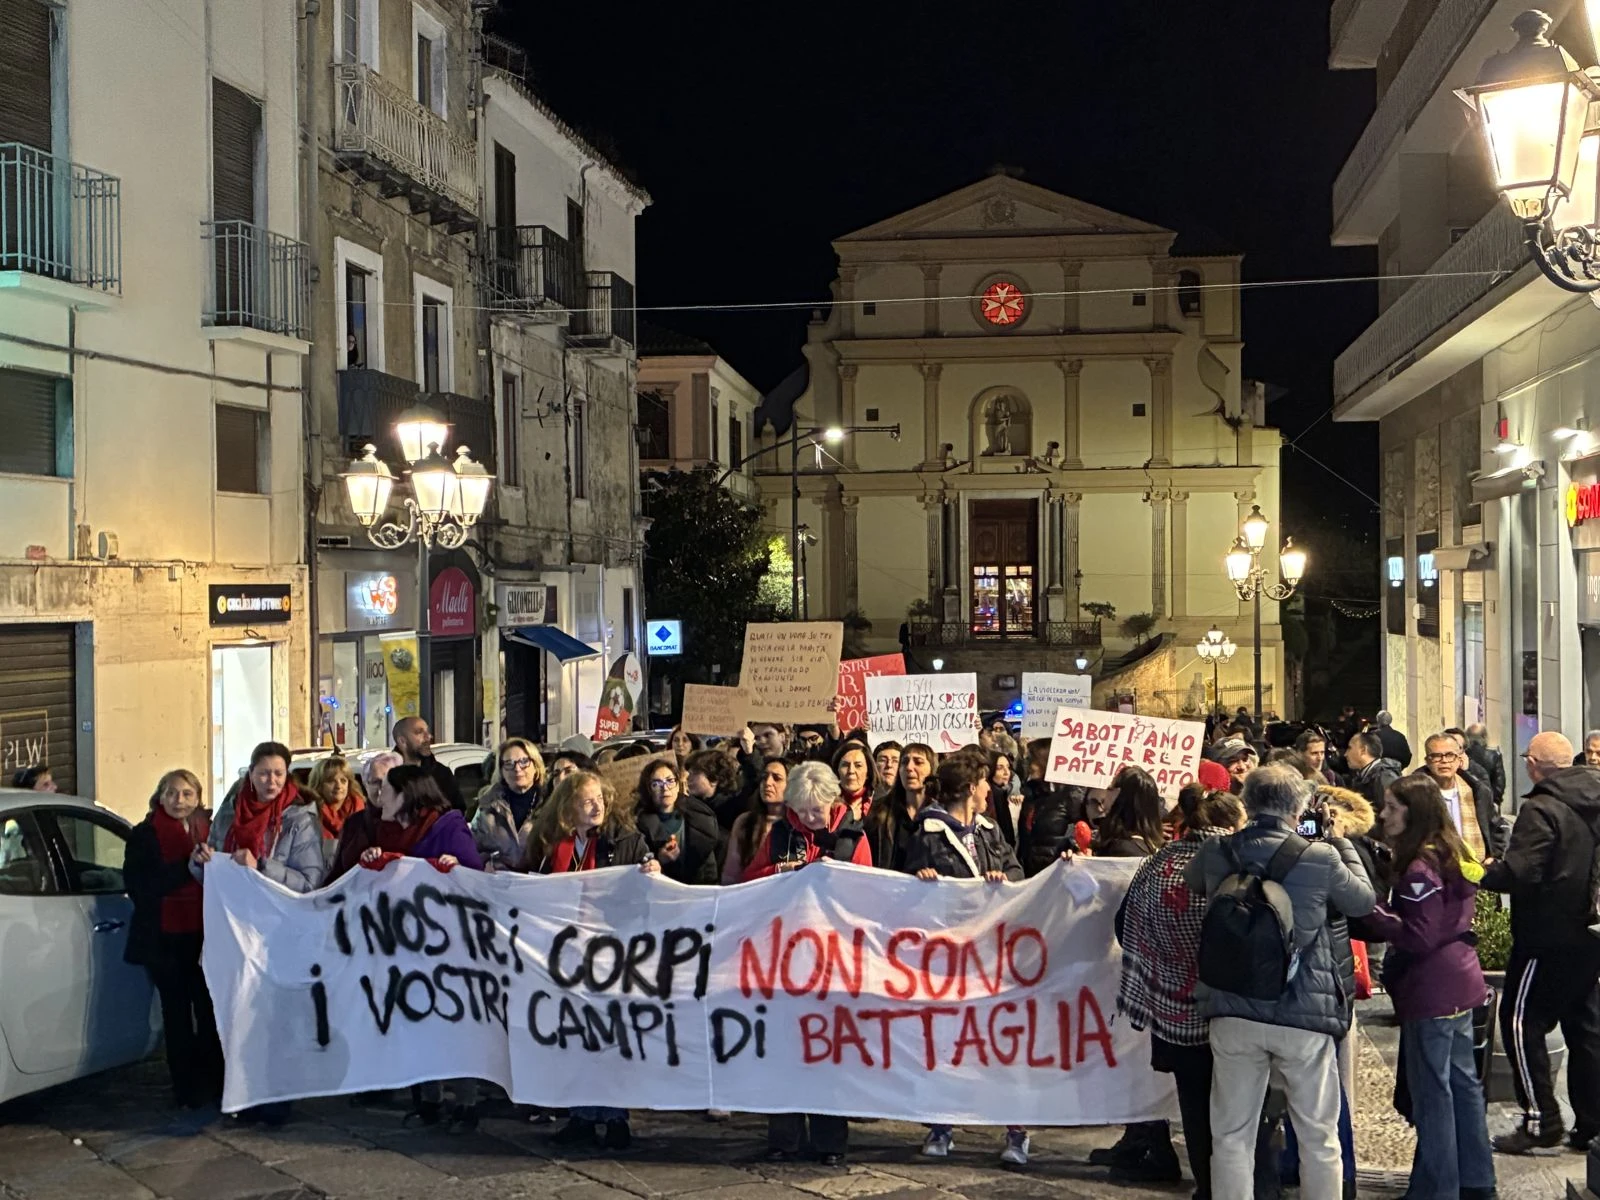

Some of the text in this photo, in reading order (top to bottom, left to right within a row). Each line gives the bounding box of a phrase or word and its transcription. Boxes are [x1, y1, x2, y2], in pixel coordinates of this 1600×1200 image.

[838, 660, 869, 674] OSTRI
[869, 699, 882, 715] LA
[885, 694, 936, 714] VIOLENZA
[939, 692, 975, 710] SPESSO
[599, 718, 620, 731] SUPER
[871, 716, 885, 733] HA
[897, 713, 928, 731] CHIAVI
[929, 714, 940, 731] DI
[942, 712, 975, 730] CASA!
[1072, 741, 1193, 767] GUERRE E
[1053, 755, 1194, 788] PATRIAATO
[738, 916, 866, 1001] NON
[884, 921, 1049, 1001] SONO
[800, 985, 1118, 1072] BATTAGLIA
